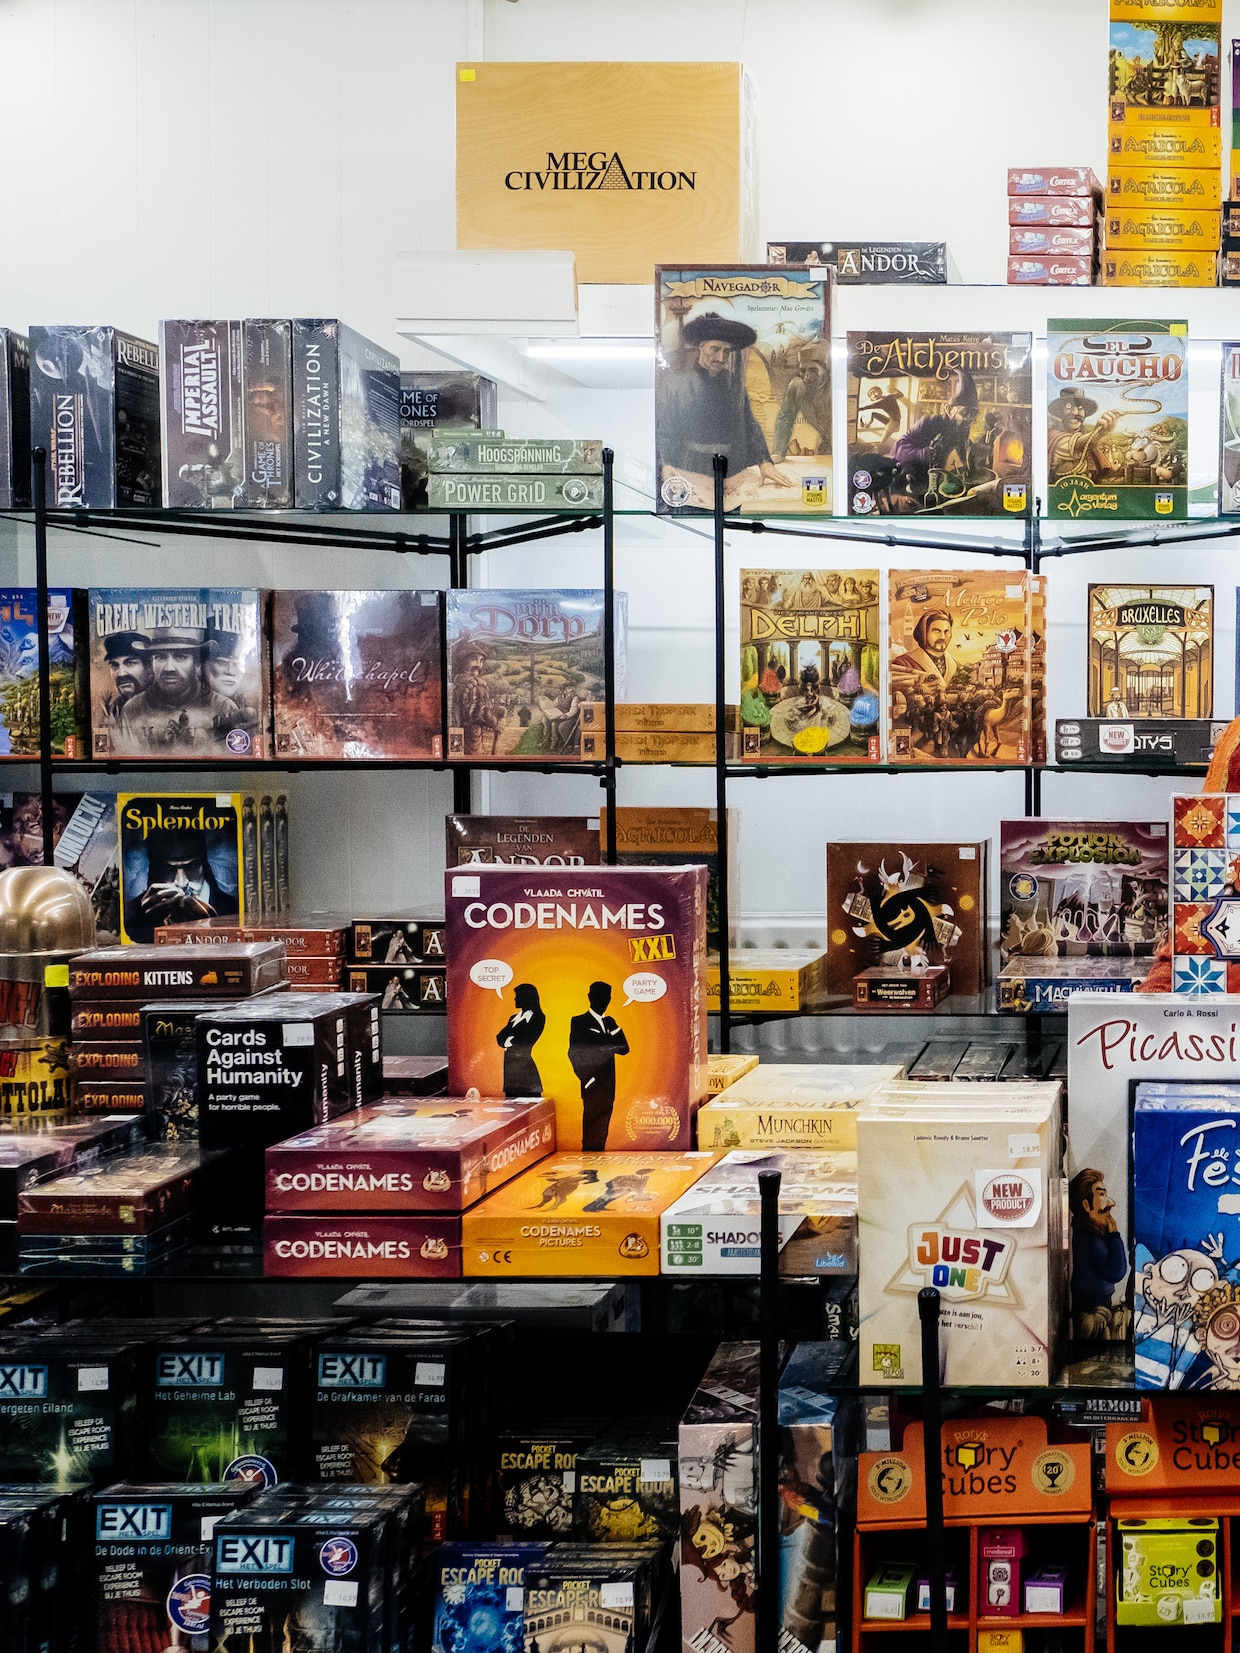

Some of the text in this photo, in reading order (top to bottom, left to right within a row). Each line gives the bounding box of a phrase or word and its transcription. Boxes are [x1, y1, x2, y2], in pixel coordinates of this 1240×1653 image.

[1125, 137, 1205, 154] AGRICOLA
[547, 151, 624, 172] MEGA
[504, 168, 696, 191] CIVILIZATION
[1050, 176, 1077, 188] CORTEX
[1052, 235, 1078, 246] CORTEX
[840, 250, 924, 276] ANDOR
[856, 341, 881, 355] De
[1105, 341, 1129, 351] EL
[1054, 354, 1182, 381] GAUCHO
[183, 339, 204, 436] IMPERIAL
[200, 349, 217, 437] ASSAULT
[425, 393, 438, 404] OF
[307, 344, 322, 484] CIVILIZATION
[58, 394, 75, 507] REBELLION
[478, 444, 561, 463] HOOGSPANNING
[445, 481, 546, 503] POWER GRID
[923, 588, 1007, 610] Marco
[96, 603, 256, 637] GREAT WESTERN TRA
[467, 604, 586, 643] Dorp
[750, 608, 869, 640] DELPHI
[953, 607, 1009, 628] Polo
[1121, 606, 1181, 625] BRUXELLES
[292, 657, 421, 690] Whitchapel
[1108, 731, 1126, 740] NEW
[55, 791, 107, 865] UNLOCK!
[125, 803, 231, 842] Splendor
[519, 825, 530, 833] DE
[497, 832, 554, 844] LEGENDEN
[1045, 831, 1123, 848] POTION
[1029, 845, 1142, 866] EXPLOSION
[523, 886, 605, 898] VLAADA CHVÁTIL
[463, 902, 666, 931] CODENAMES
[630, 935, 674, 962] XXL
[75, 970, 193, 987] EXPLODING KITTENS
[477, 974, 506, 983] SECRET
[483, 966, 500, 974] TOP
[631, 979, 658, 988] PARTY
[633, 988, 657, 996] GAME
[876, 987, 916, 997] Weerwolven
[77, 1012, 140, 1028] EXPLODING
[1163, 1009, 1219, 1017] Carlo A. Rossi
[205, 1028, 267, 1046] Cards
[206, 1048, 283, 1069] Against
[206, 1068, 303, 1088] Humanity
[215, 1094, 236, 1103] party
[239, 1095, 261, 1103] game
[208, 1103, 281, 1113] for horrible people.
[757, 1115, 833, 1137] MUNCHKIN
[1022, 1145, 1040, 1153] 19.95
[276, 1172, 413, 1192] CODENAMES
[992, 1183, 1023, 1198] NEW
[991, 1198, 1028, 1210] PRODUCT
[520, 1225, 602, 1238] CODENAMES
[276, 1240, 411, 1260] CODENAMES
[538, 1237, 584, 1248] PICTURES
[916, 1231, 1006, 1272] JUST
[932, 1264, 982, 1292] ONE
[160, 1356, 221, 1383] EXIT
[155, 1390, 236, 1401] Het Geheime Lab
[317, 1391, 446, 1403] De Grafkamer van de Farao
[614, 1467, 641, 1477] POCKET
[581, 1476, 632, 1494] ESCAPE
[99, 1507, 167, 1536] EXIT
[95, 1545, 109, 1556] De
[110, 1544, 136, 1556] Dode
[137, 1545, 147, 1555] in
[151, 1545, 164, 1555] de
[220, 1538, 291, 1571] EXIT
[986, 1548, 1013, 1556] medieval
[215, 1578, 312, 1590] Het Verboden Slot
[1149, 1576, 1190, 1588] Cubes
